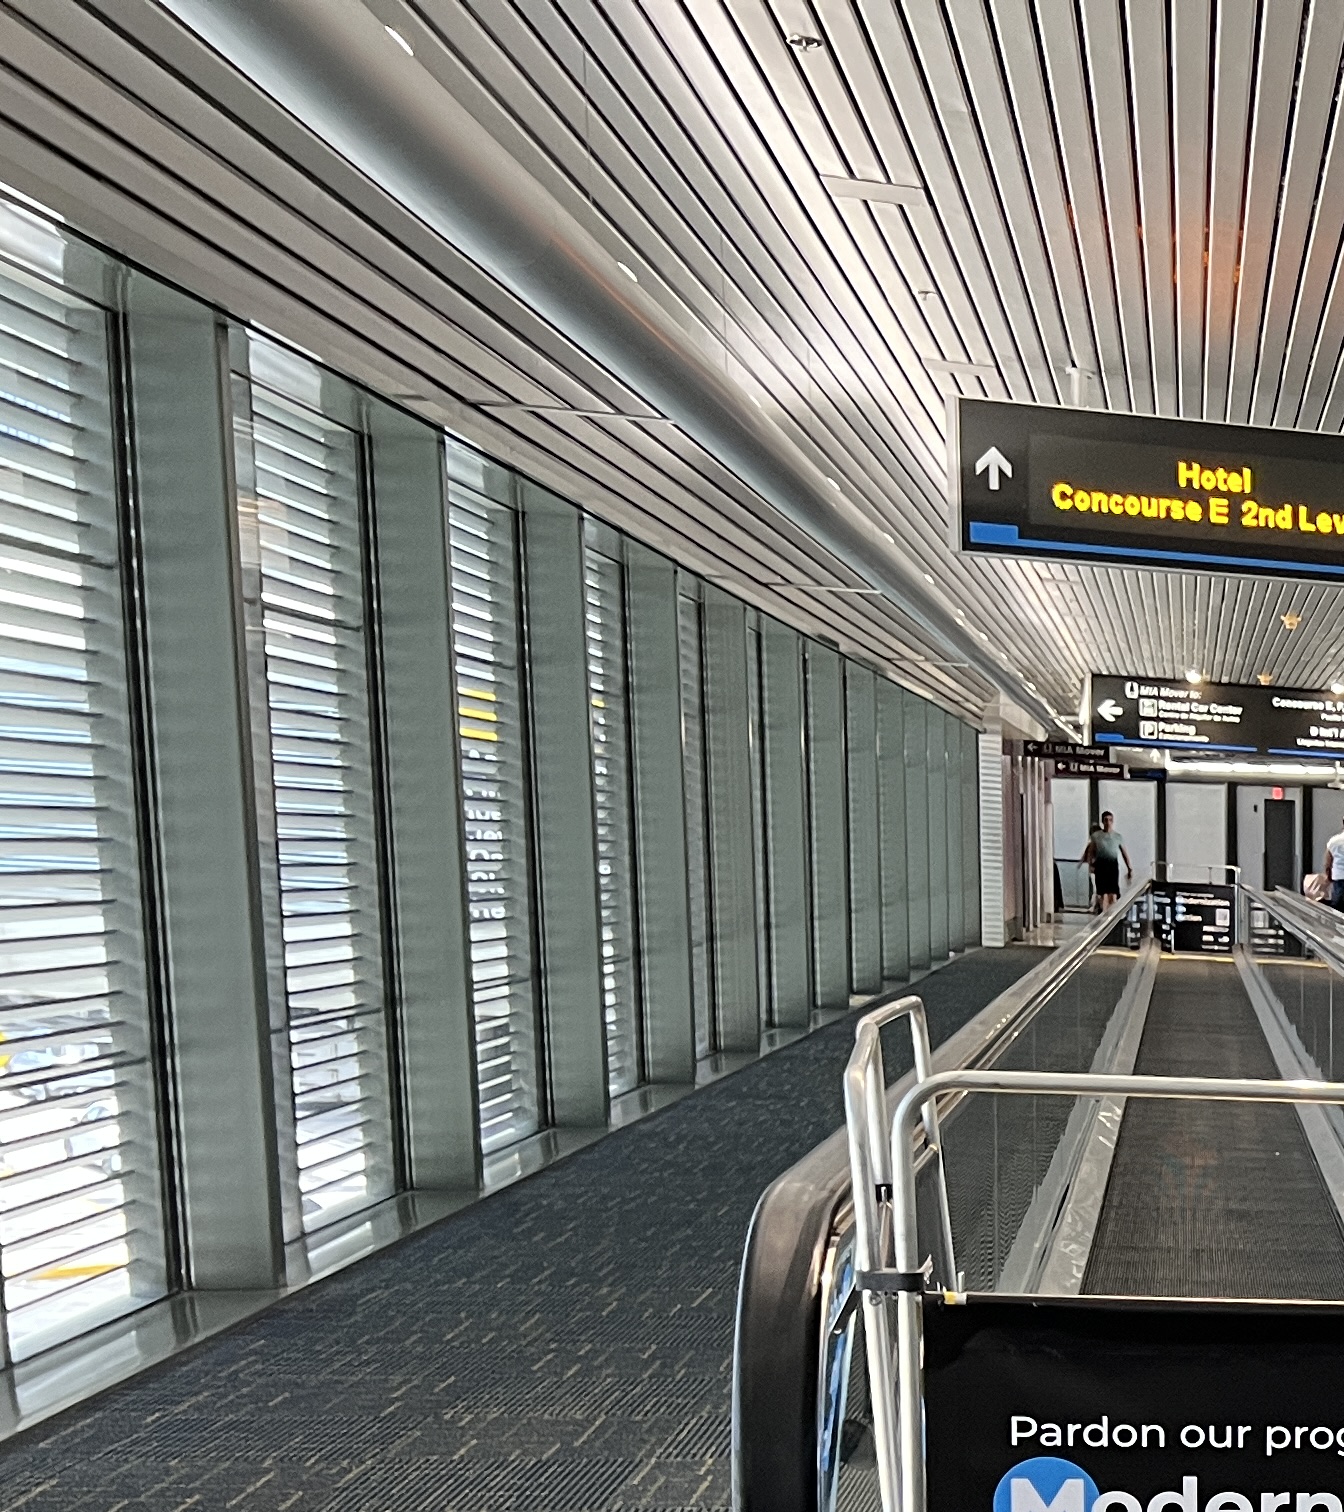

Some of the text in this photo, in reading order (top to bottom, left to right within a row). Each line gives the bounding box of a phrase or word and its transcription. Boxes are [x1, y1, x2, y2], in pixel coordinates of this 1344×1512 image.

[1178, 460, 1251, 493] Hotel
[1051, 482, 1203, 522] Concourse
[1208, 497, 1229, 524] E
[1241, 500, 1293, 531] 2nd
[1010, 1416, 1167, 1448] Pardon
[1180, 1423, 1253, 1449] our
